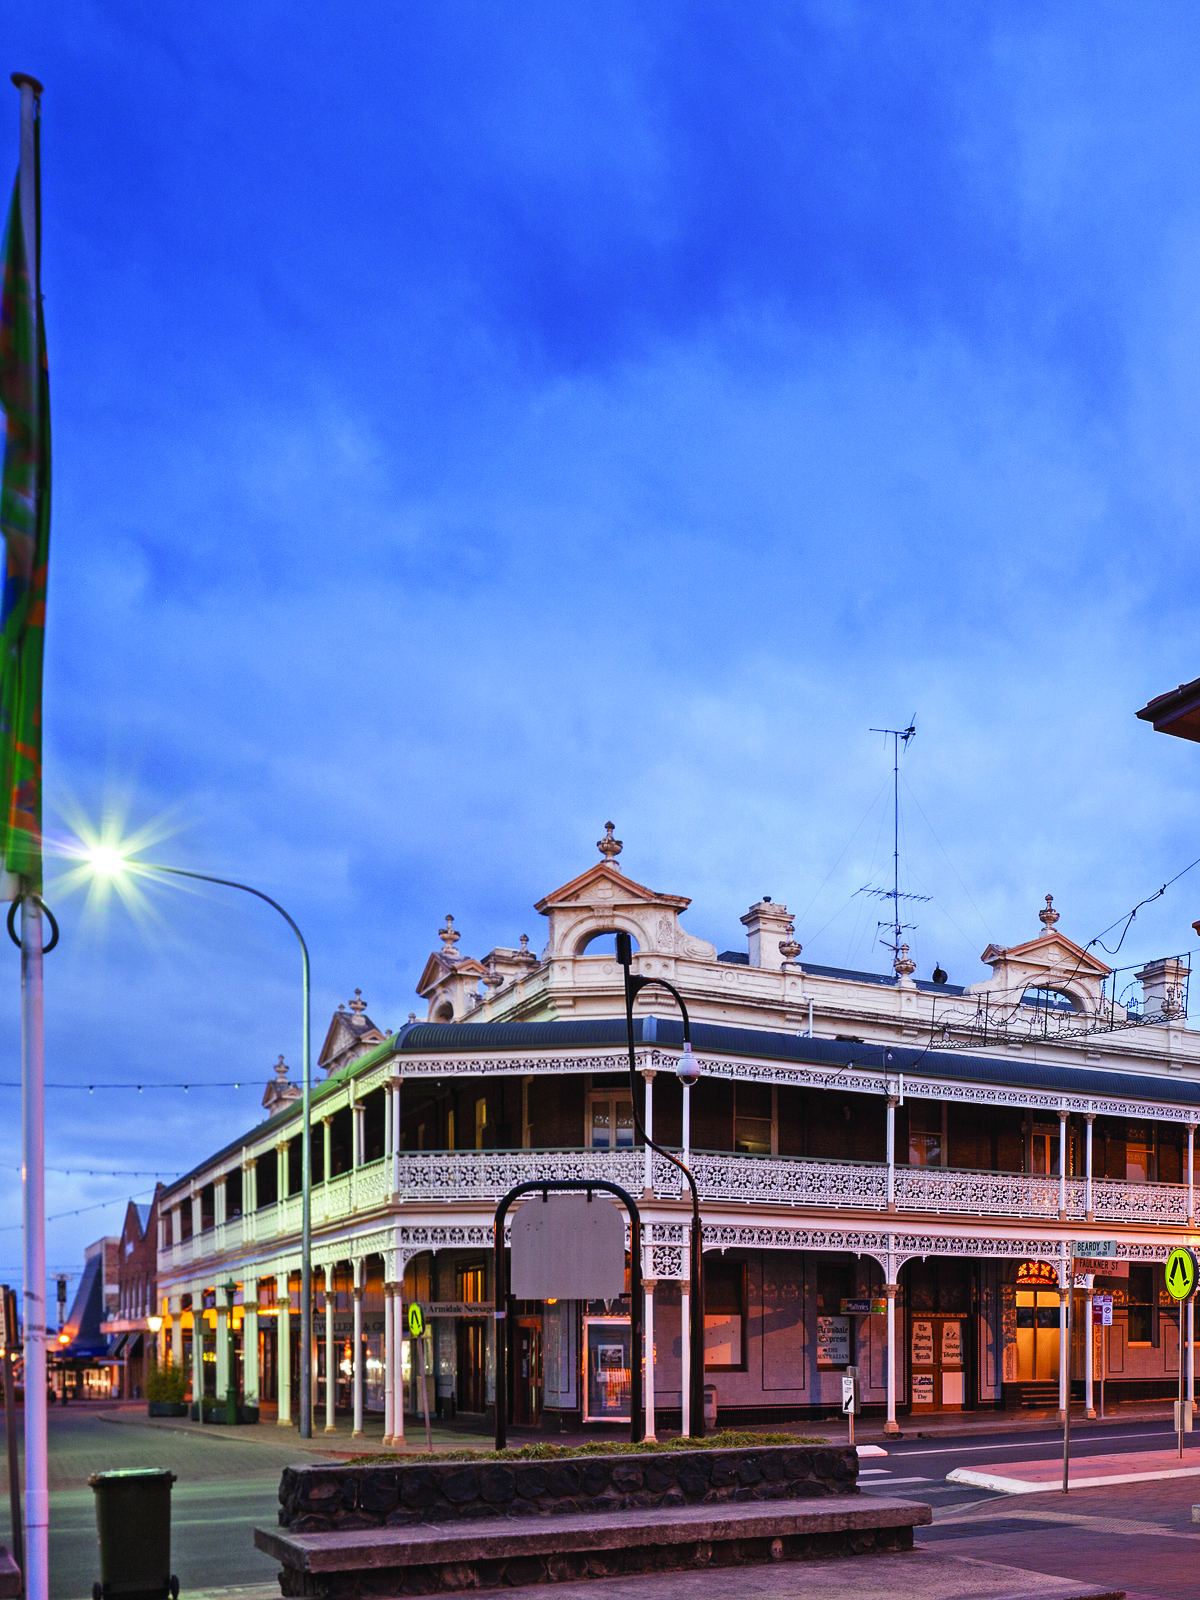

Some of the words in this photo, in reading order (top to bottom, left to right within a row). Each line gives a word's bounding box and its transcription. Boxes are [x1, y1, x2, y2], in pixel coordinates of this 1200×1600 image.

[1077, 1241, 1101, 1252] BEARDY
[1103, 1241, 1111, 1251] ST
[1079, 1259, 1109, 1269] FAULKNER
[1111, 1260, 1119, 1271] ST
[428, 1305, 463, 1313] Armidale
[464, 1305, 495, 1315] Newsage
[363, 1322, 371, 1332] &
[918, 1323, 928, 1332] The
[818, 1334, 847, 1344] Express
[914, 1332, 931, 1342] Sydney
[913, 1343, 933, 1352] Morning
[914, 1352, 931, 1361] Herald
[917, 1393, 928, 1401] Day
